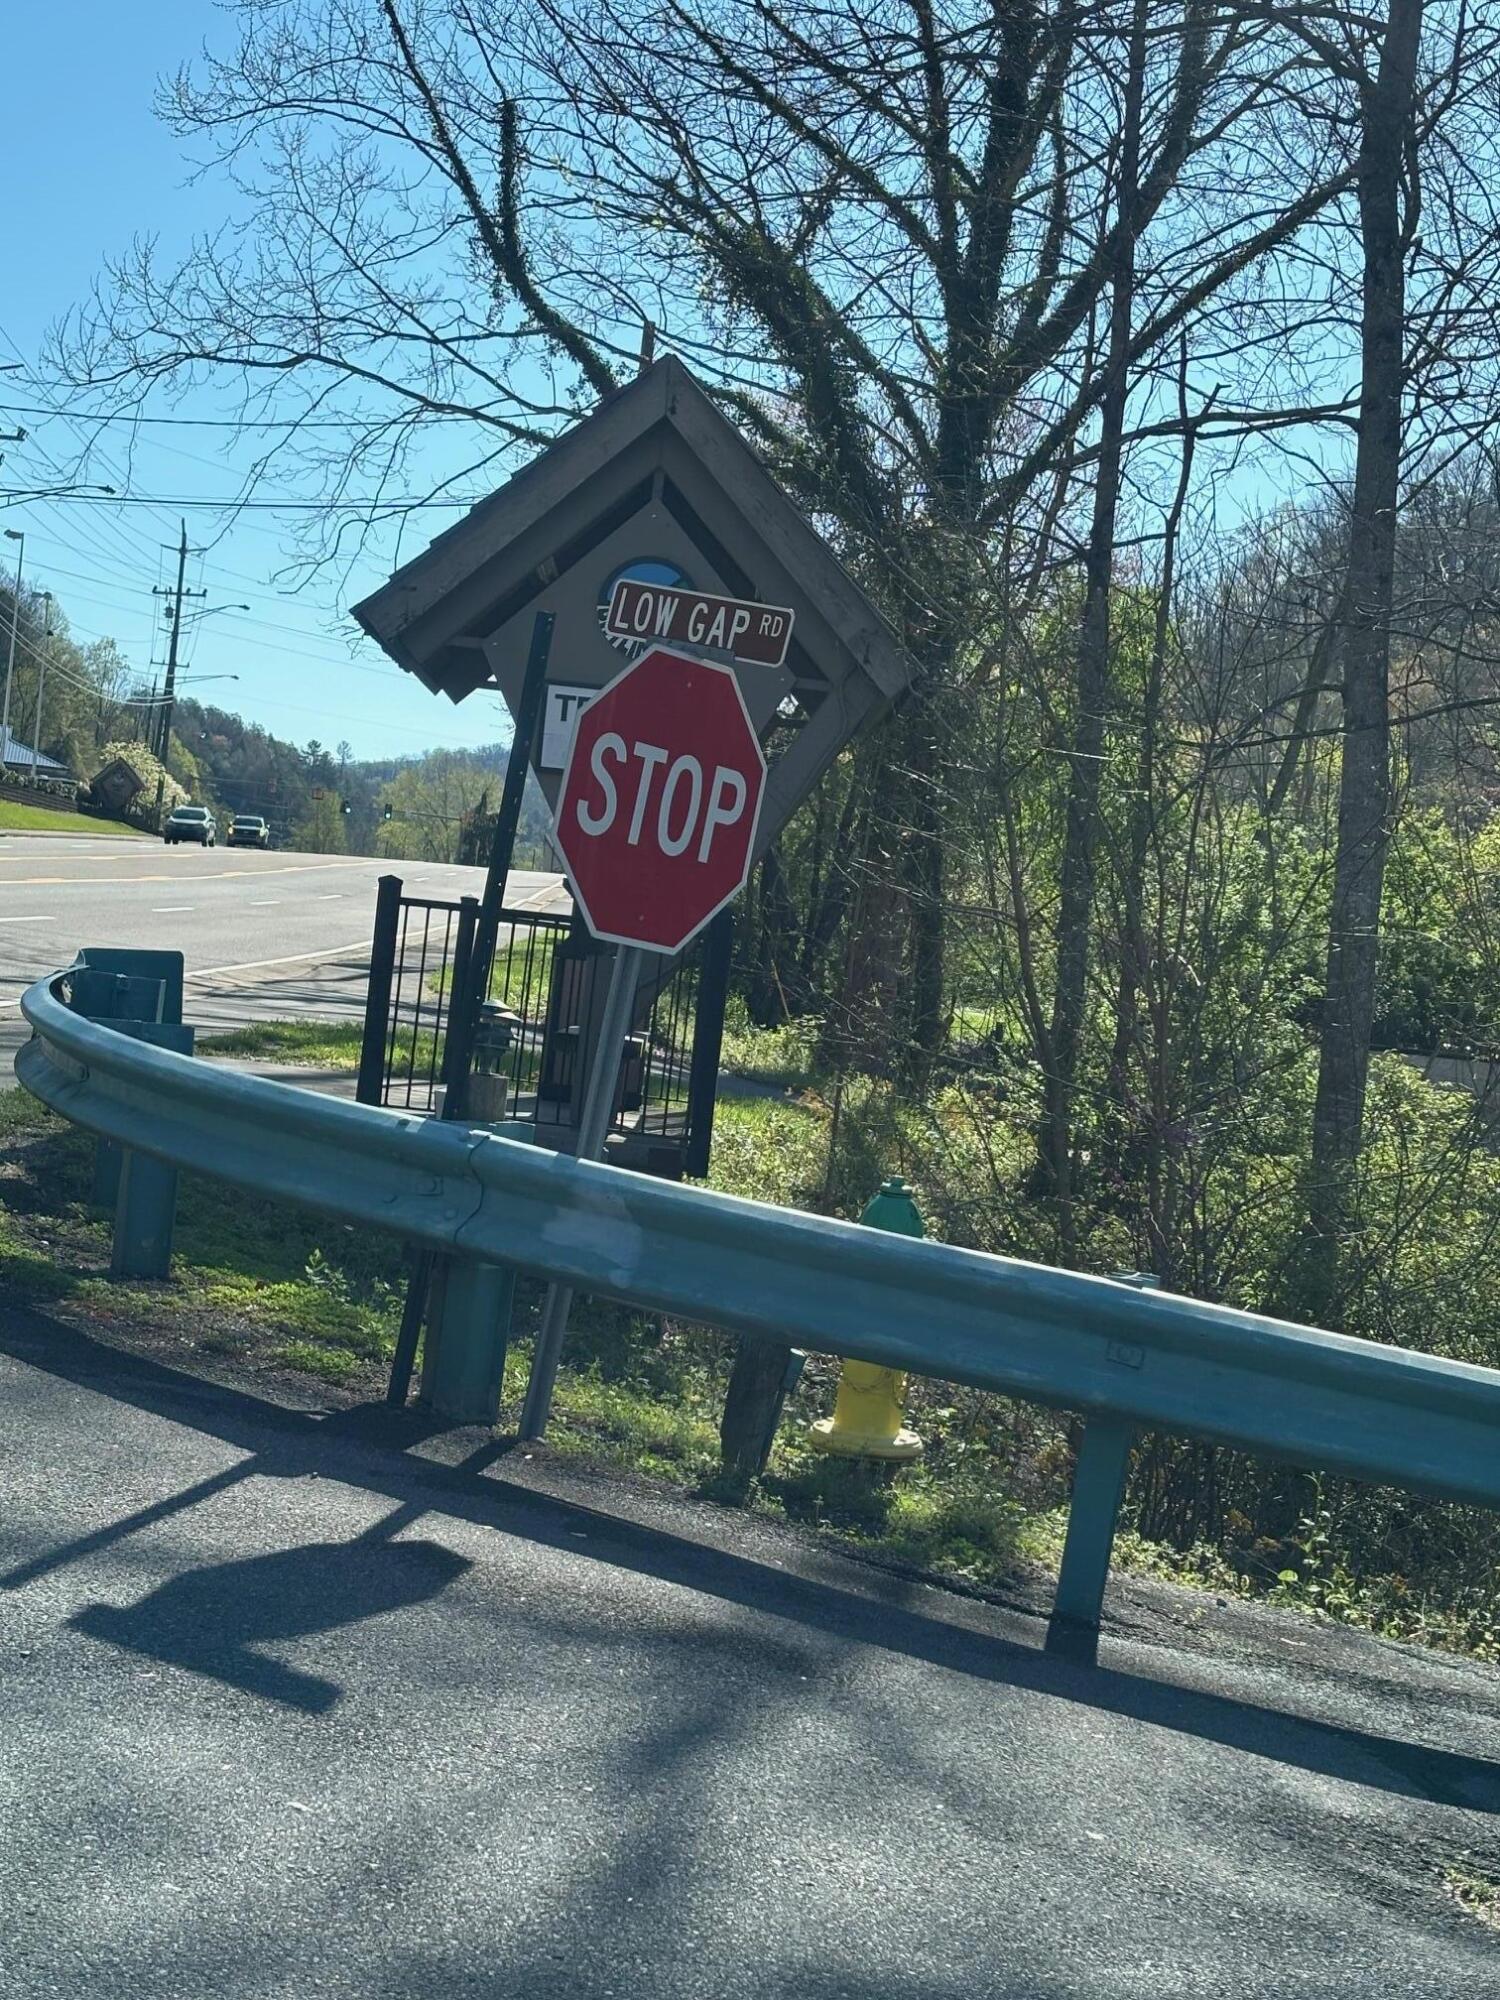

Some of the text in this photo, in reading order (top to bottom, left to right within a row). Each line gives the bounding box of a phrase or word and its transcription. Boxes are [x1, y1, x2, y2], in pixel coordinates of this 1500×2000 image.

[614, 587, 679, 637] LOW
[687, 602, 751, 650] GAP
[758, 613, 784, 638] RD
[576, 731, 747, 864] STOP
